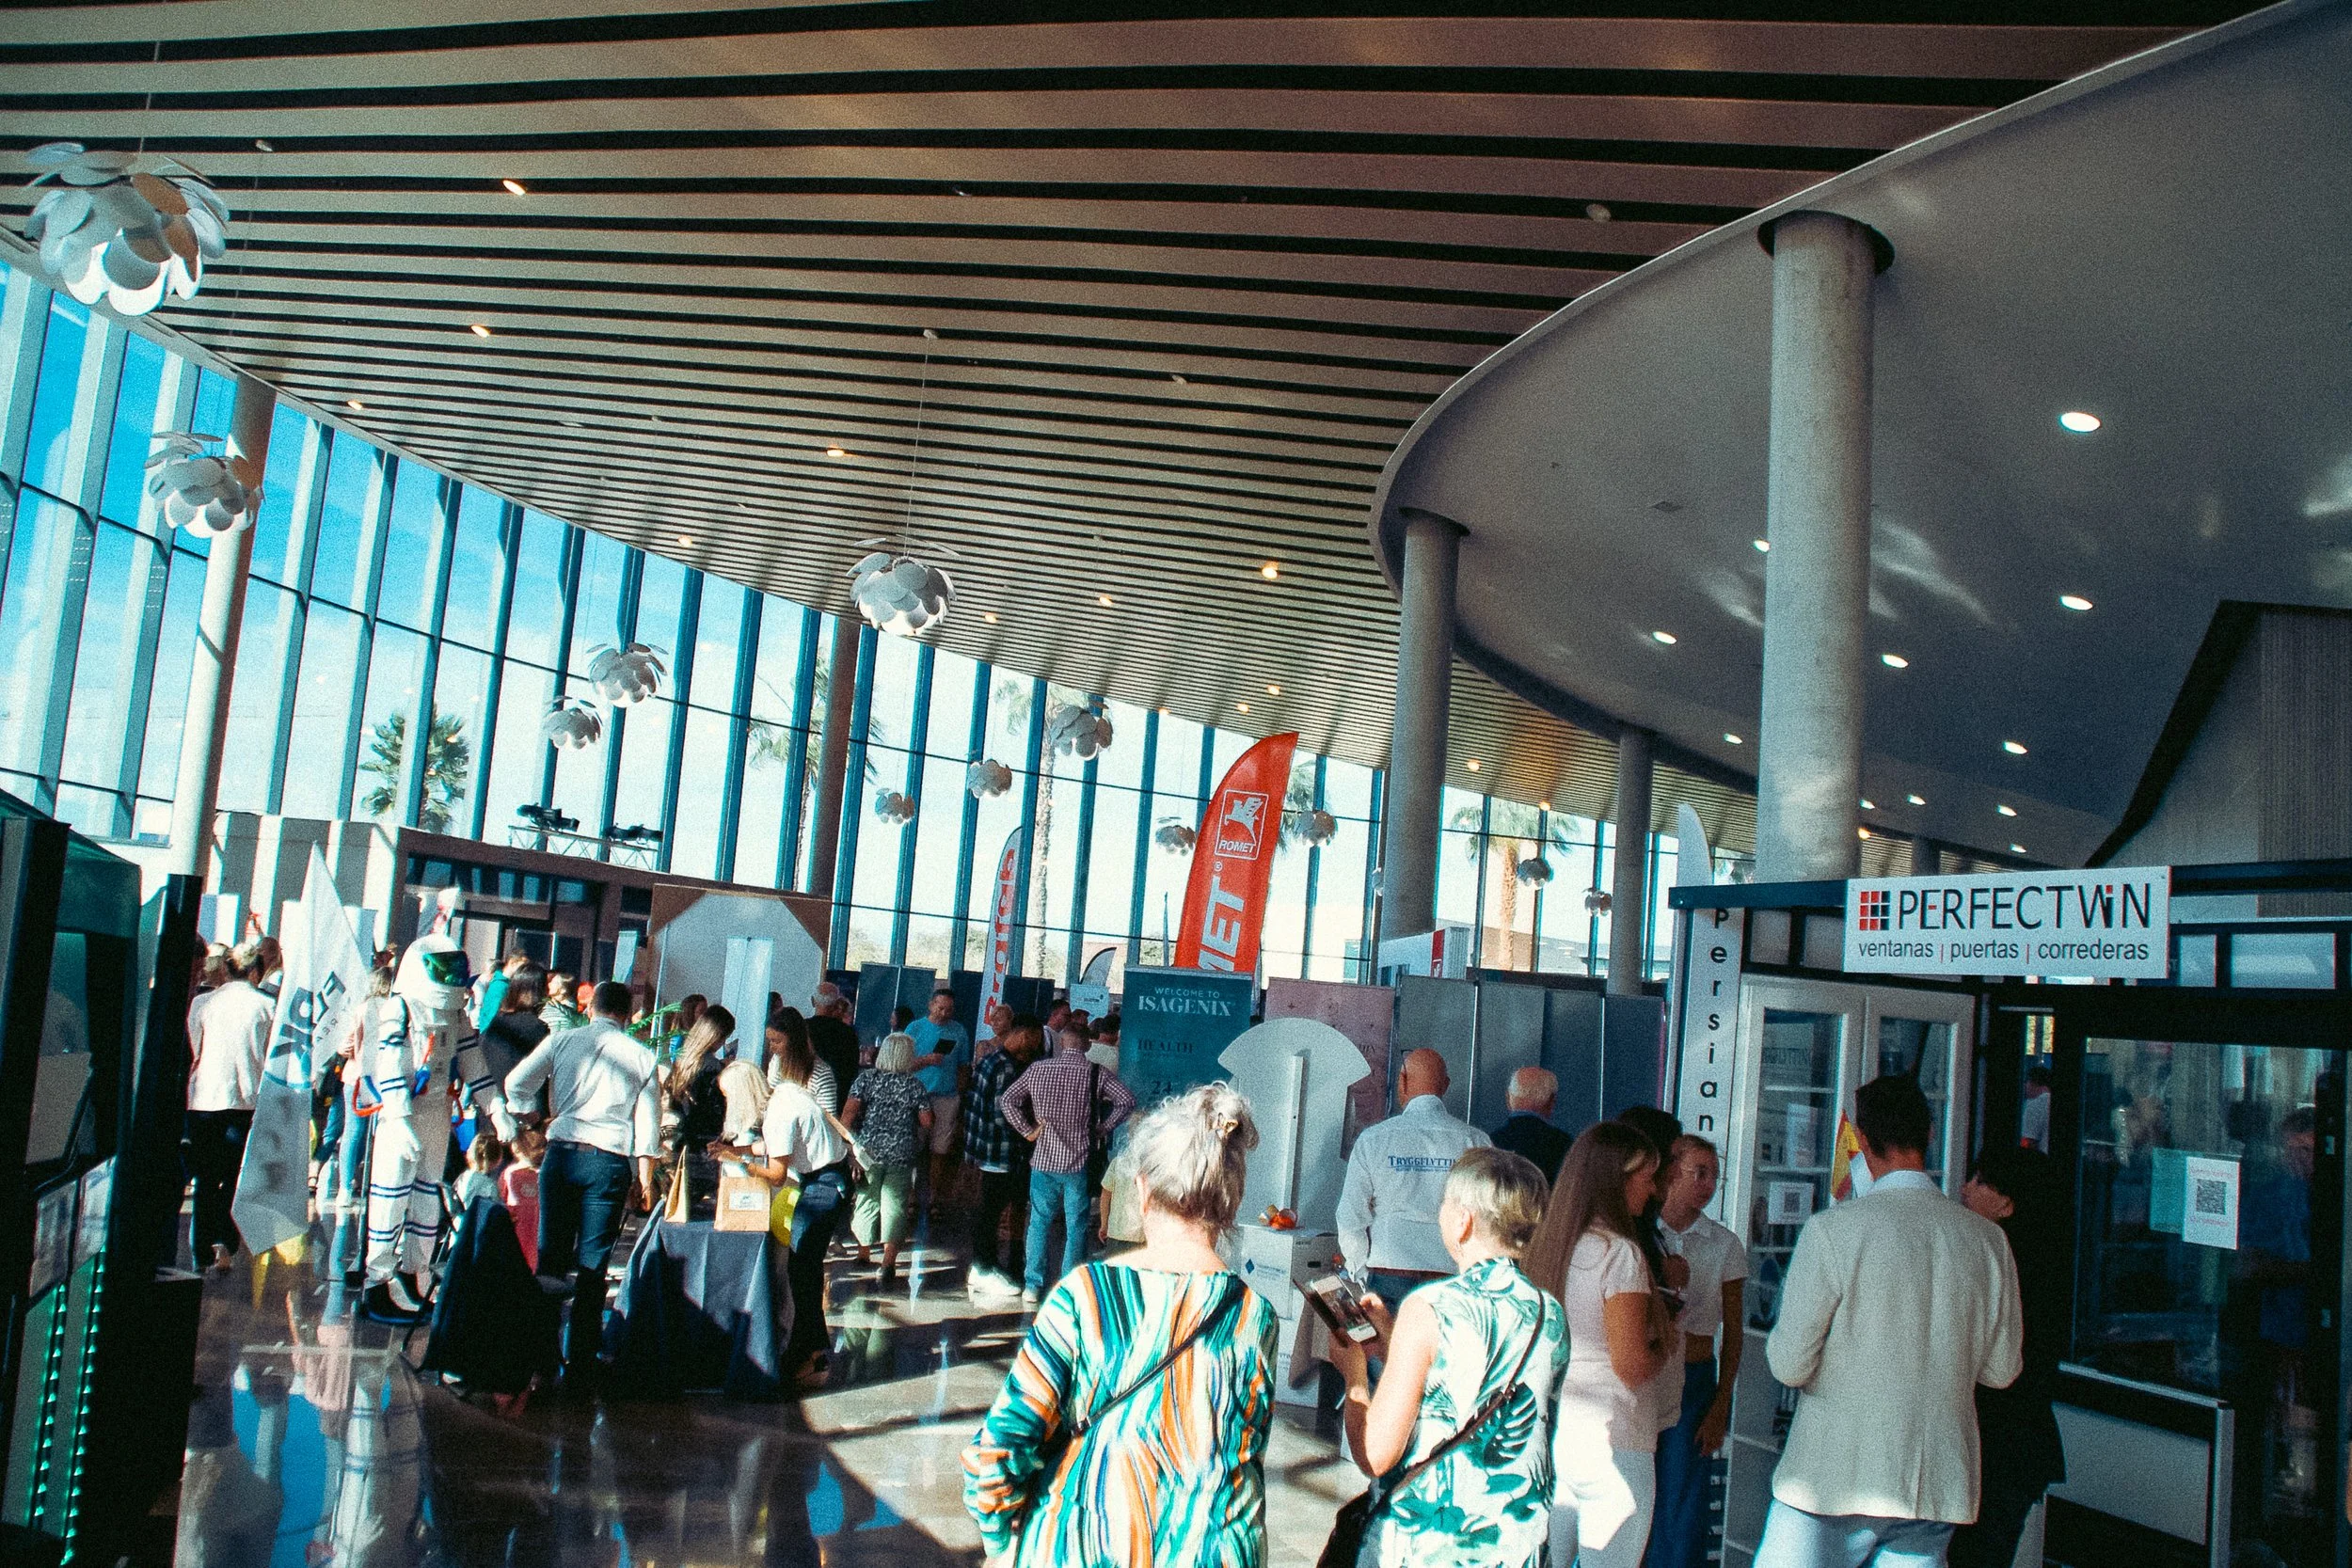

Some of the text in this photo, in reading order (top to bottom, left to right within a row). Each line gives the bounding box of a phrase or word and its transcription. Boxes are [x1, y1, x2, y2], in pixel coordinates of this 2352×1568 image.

[1218, 840, 1256, 853] ROMET
[1859, 939, 2150, 962] ventanas puertas correderas
[1154, 987, 1220, 999] WELCOME TO
[1138, 995, 1231, 1016] ISAGENIX
